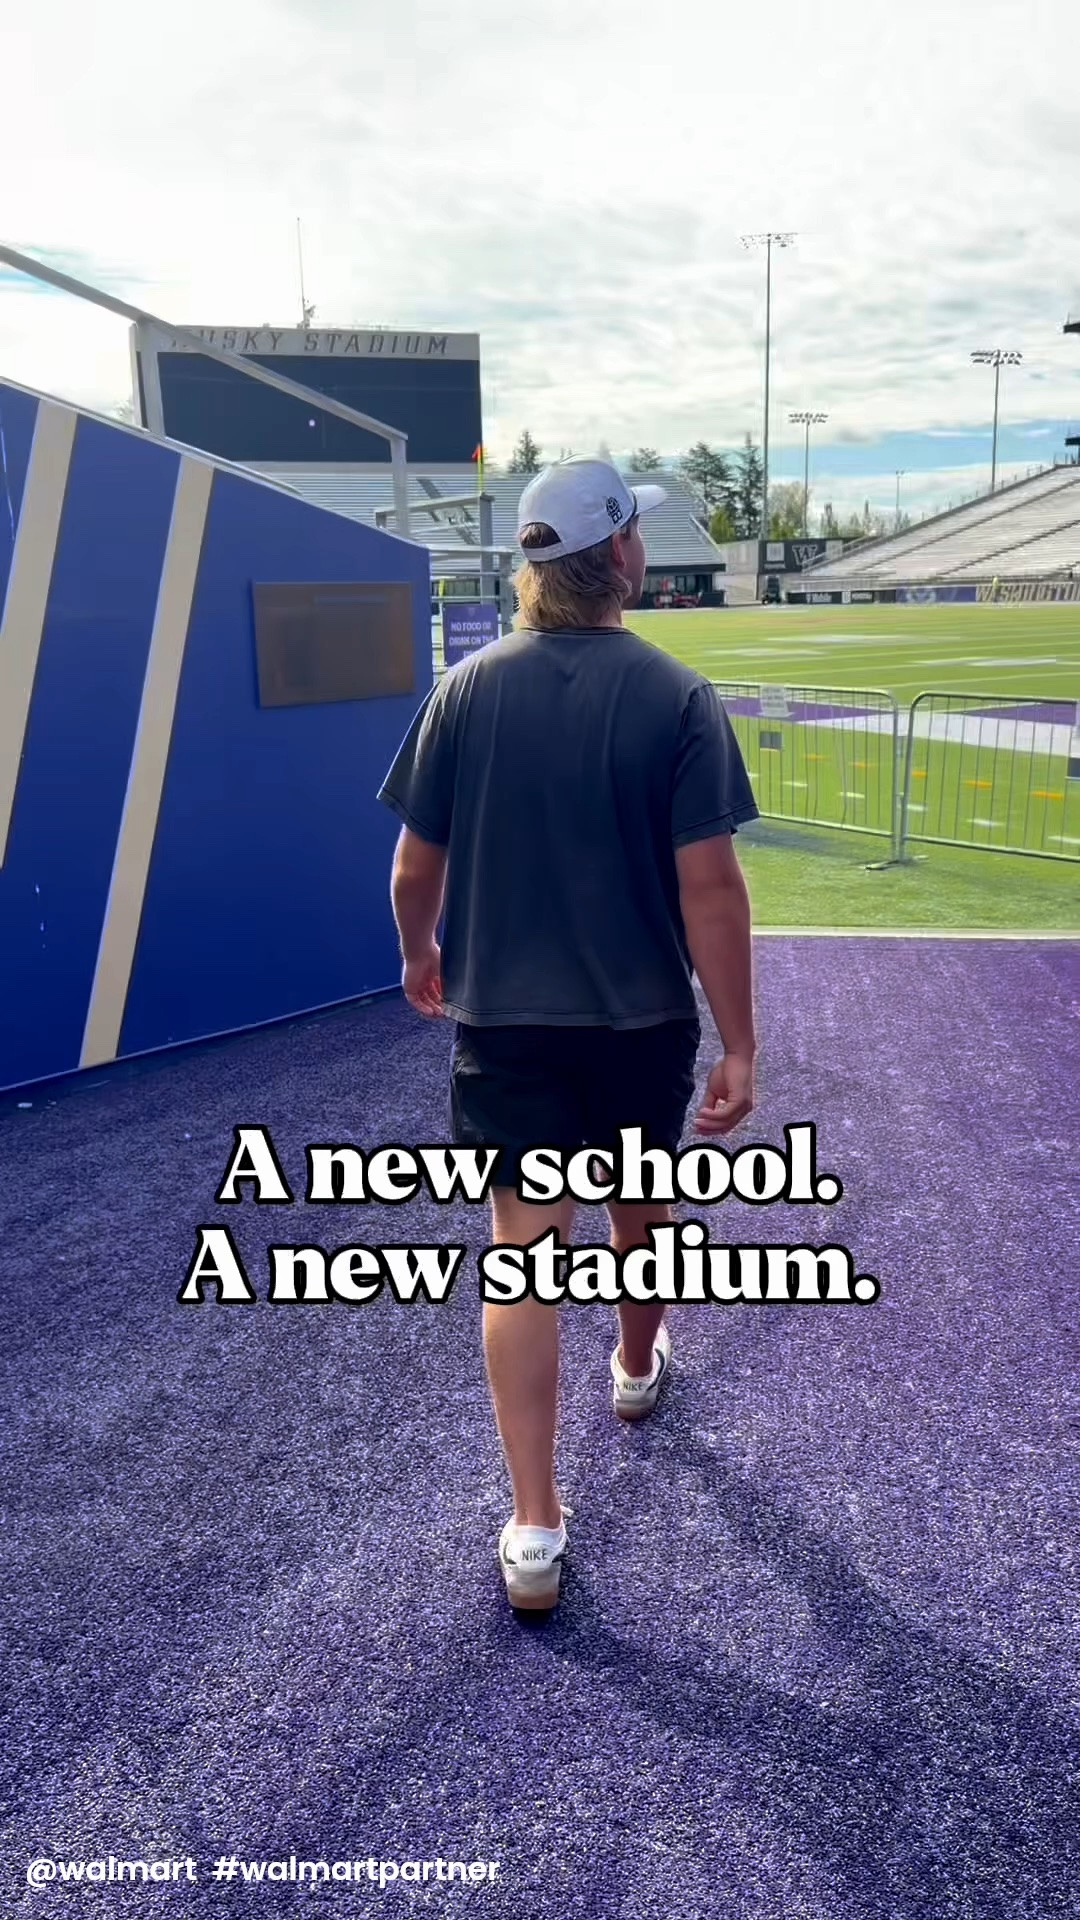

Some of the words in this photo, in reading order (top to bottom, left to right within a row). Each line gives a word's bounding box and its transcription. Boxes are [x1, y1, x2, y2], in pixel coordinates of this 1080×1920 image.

[172, 330, 283, 351] USKY
[304, 333, 448, 354] STADIUM
[451, 622, 461, 632] NO
[462, 622, 481, 632] FOOD
[624, 1381, 645, 1392] NIKE
[522, 1547, 548, 1561] NIKE
